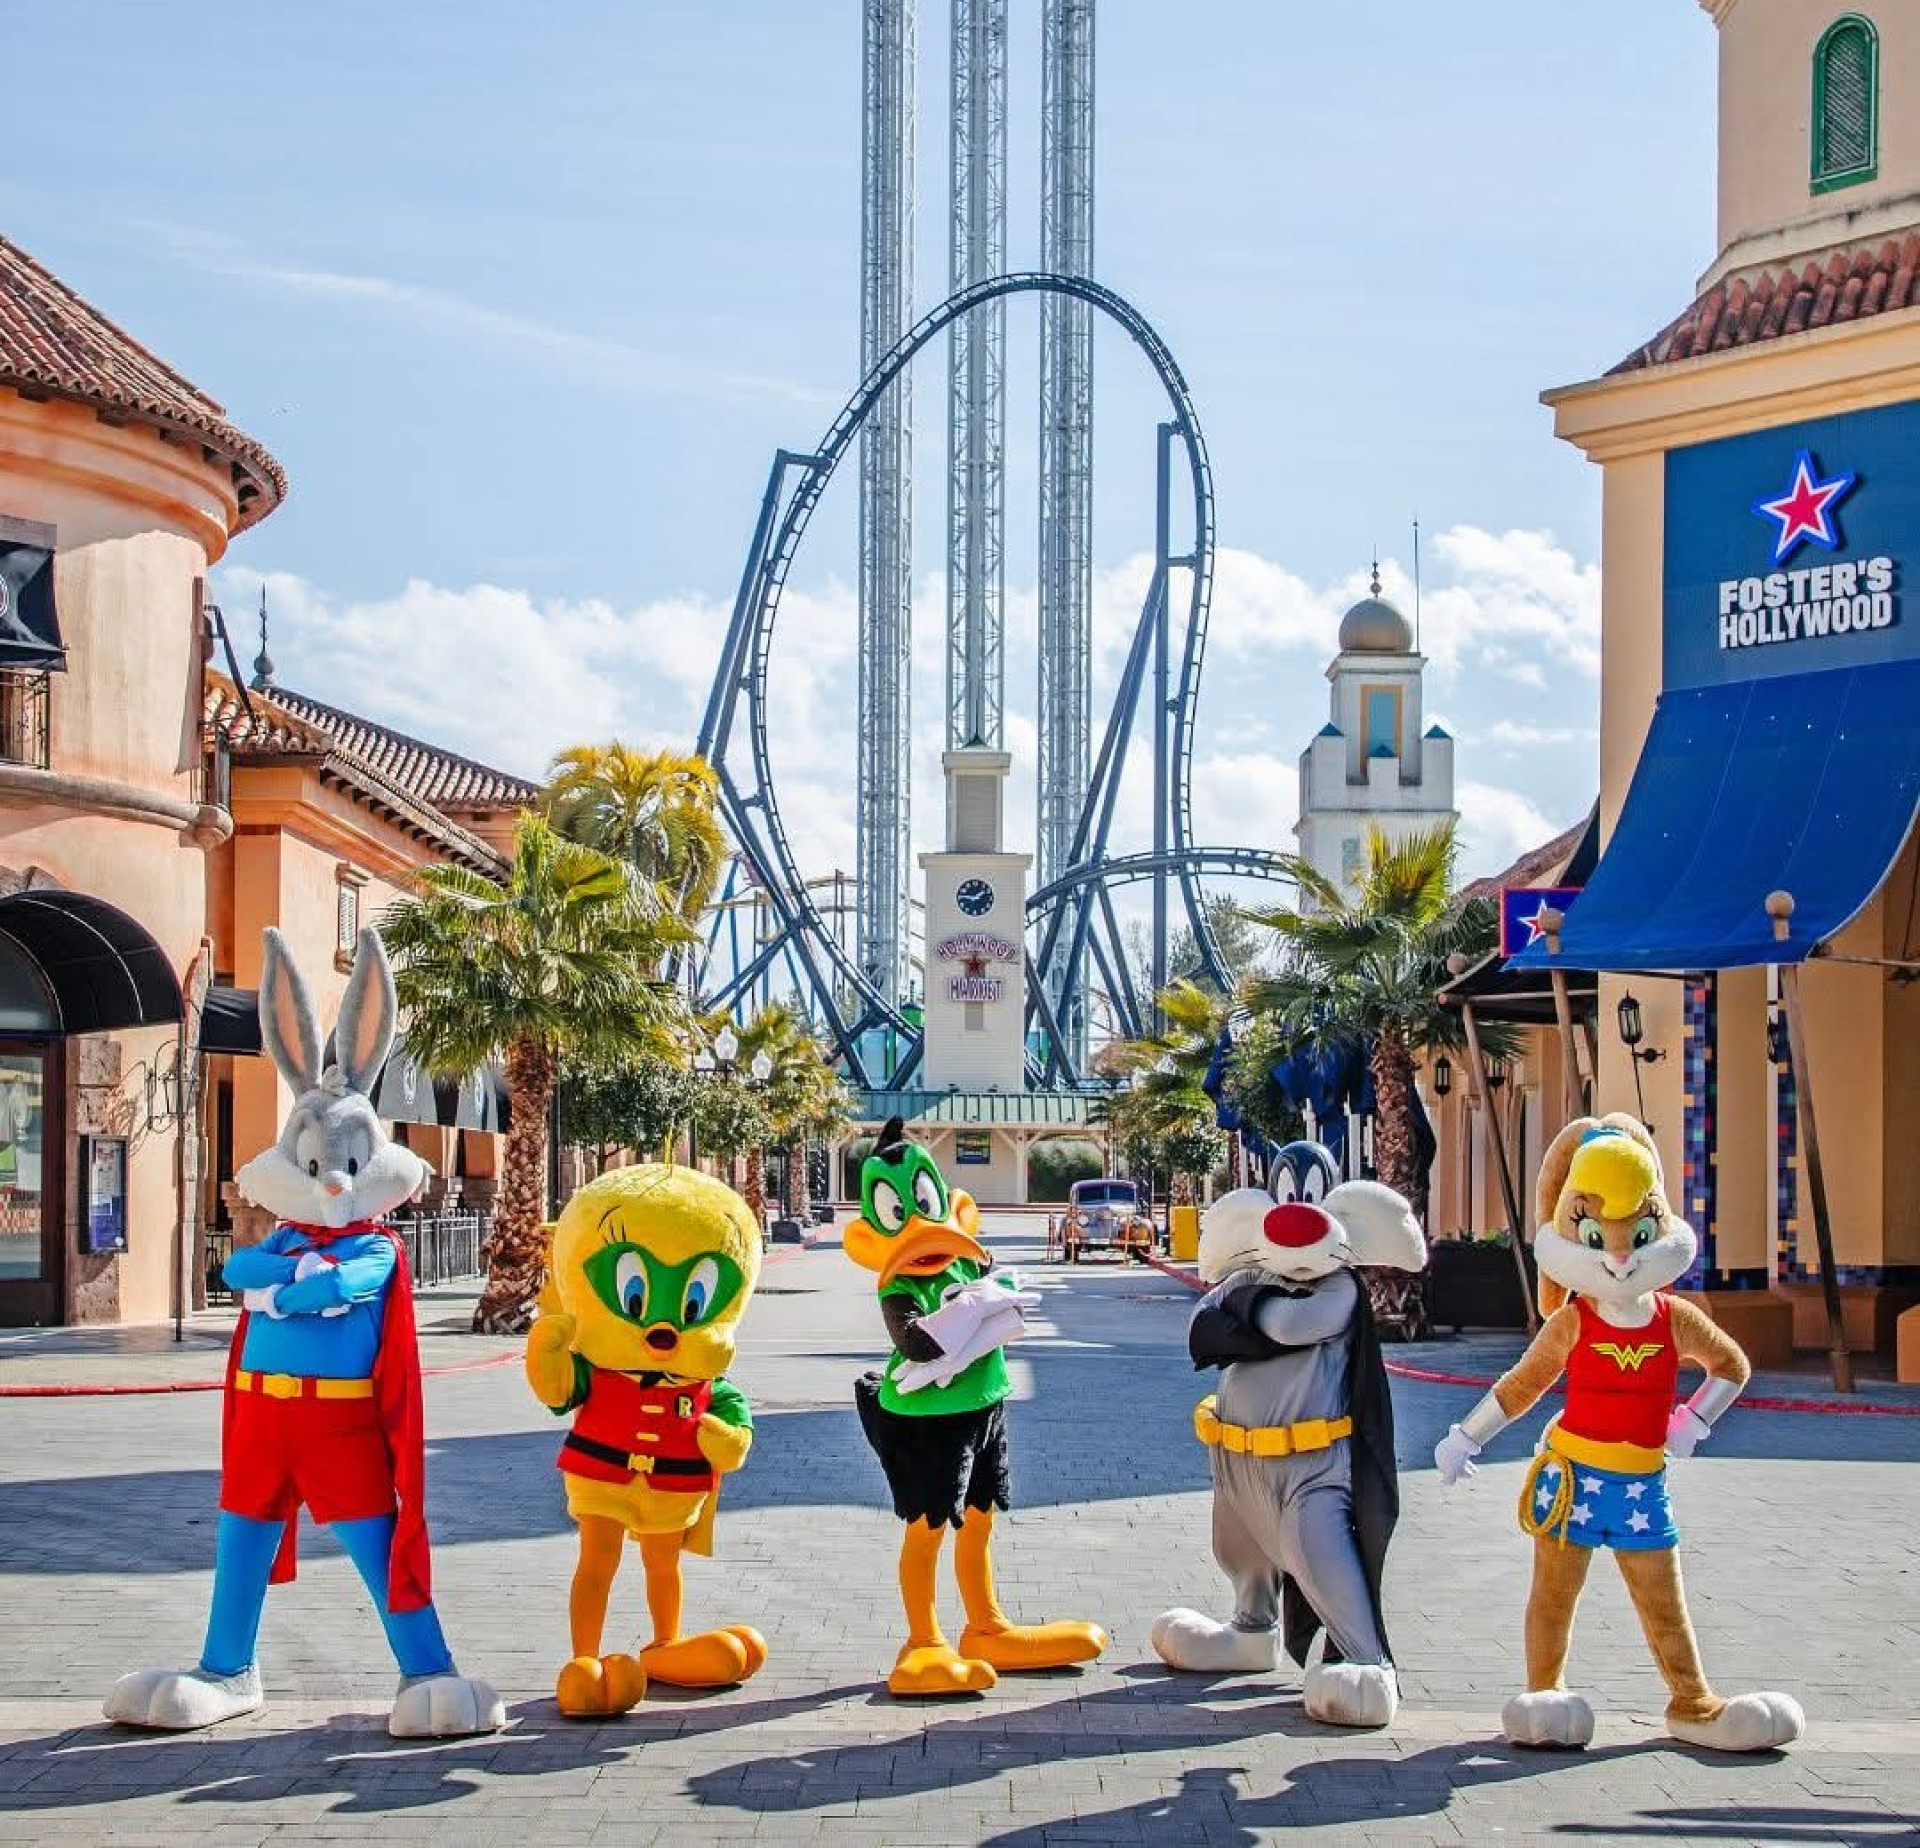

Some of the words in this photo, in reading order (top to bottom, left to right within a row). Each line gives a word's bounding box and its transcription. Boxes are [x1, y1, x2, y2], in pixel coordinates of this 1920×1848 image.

[1719, 556, 1893, 615] FOSTER'S
[1719, 592, 1893, 650] HOLLYWOOD
[678, 1396, 693, 1418] R
